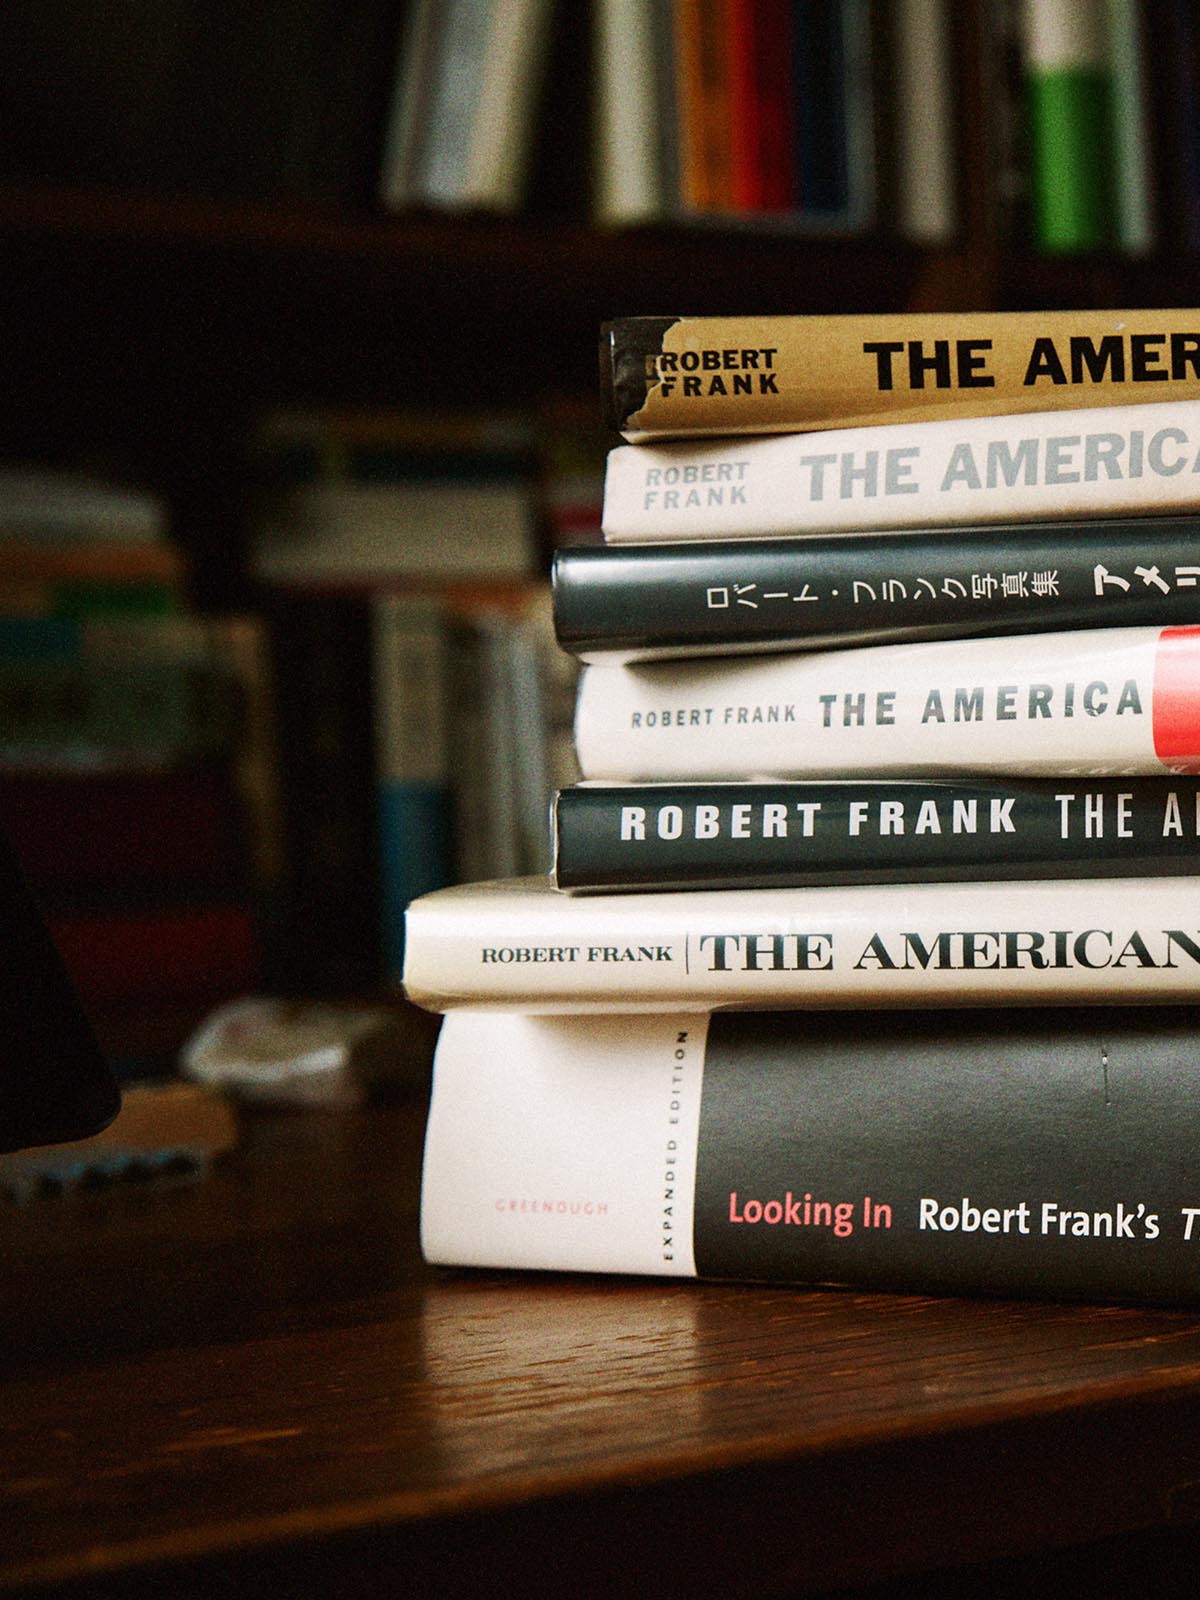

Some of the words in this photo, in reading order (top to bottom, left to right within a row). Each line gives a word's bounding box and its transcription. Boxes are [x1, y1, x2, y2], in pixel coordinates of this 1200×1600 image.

[660, 348, 777, 372] ROBERT
[863, 339, 996, 391] THE
[660, 373, 779, 398] FRANK
[646, 461, 749, 486] ROBERT
[800, 447, 921, 502] THE
[643, 485, 747, 511] FRANK
[707, 569, 1061, 610] ロバート・フランク写真集
[631, 708, 713, 729] ROBERT
[723, 704, 796, 724] FRANK
[819, 691, 896, 728] THE
[620, 802, 822, 841] ROBERT
[848, 798, 1016, 836] FRANK
[1054, 793, 1134, 840] THE
[481, 947, 580, 964] ROBERT
[587, 946, 673, 963] FRANK
[699, 934, 834, 972] THE
[669, 1030, 689, 1125] EDITION
[494, 1199, 609, 1217] GREENOUGH
[662, 1139, 678, 1262] EXPANDED
[729, 1191, 854, 1237] Looking
[863, 1196, 892, 1228] In
[919, 1197, 1031, 1234] Robert
[1041, 1202, 1160, 1239] Frank’s
